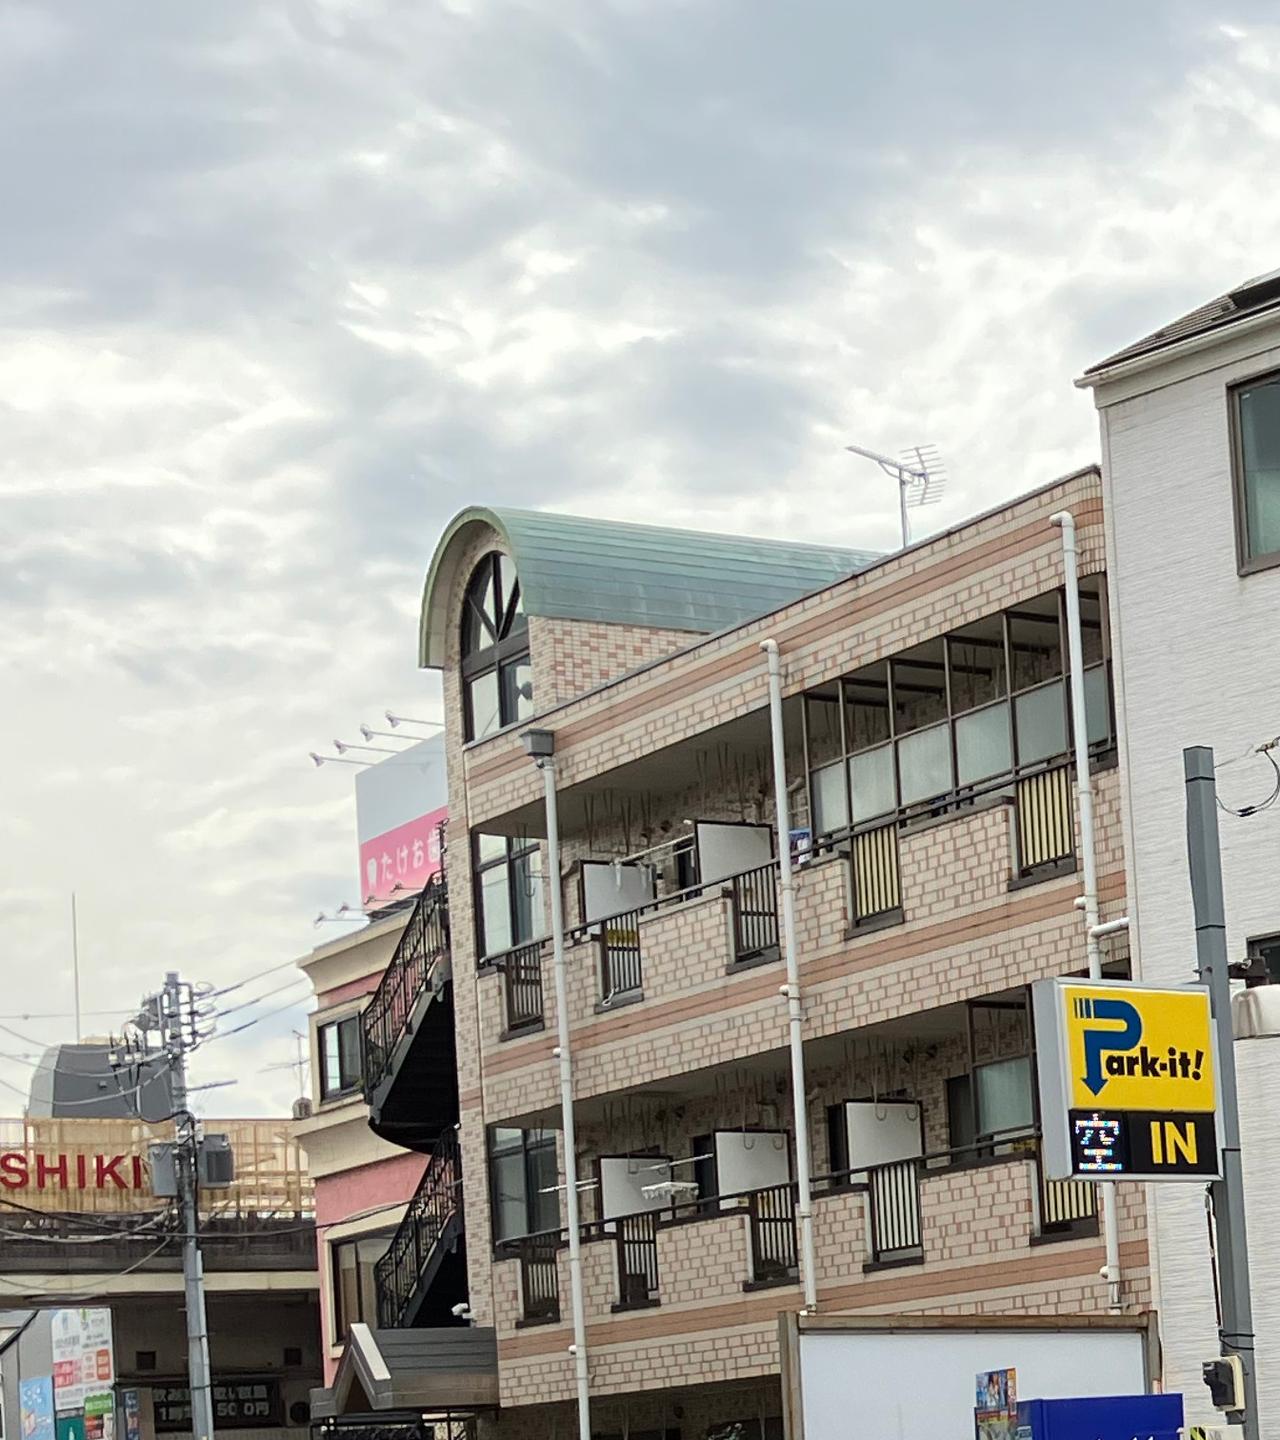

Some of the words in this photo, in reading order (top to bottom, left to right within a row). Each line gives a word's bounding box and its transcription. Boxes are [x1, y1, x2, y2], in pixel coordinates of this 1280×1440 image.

[1073, 998, 1204, 1097] Park-it!
[1075, 1113, 1123, 1170] 空
[1150, 1121, 1199, 1164] IN
